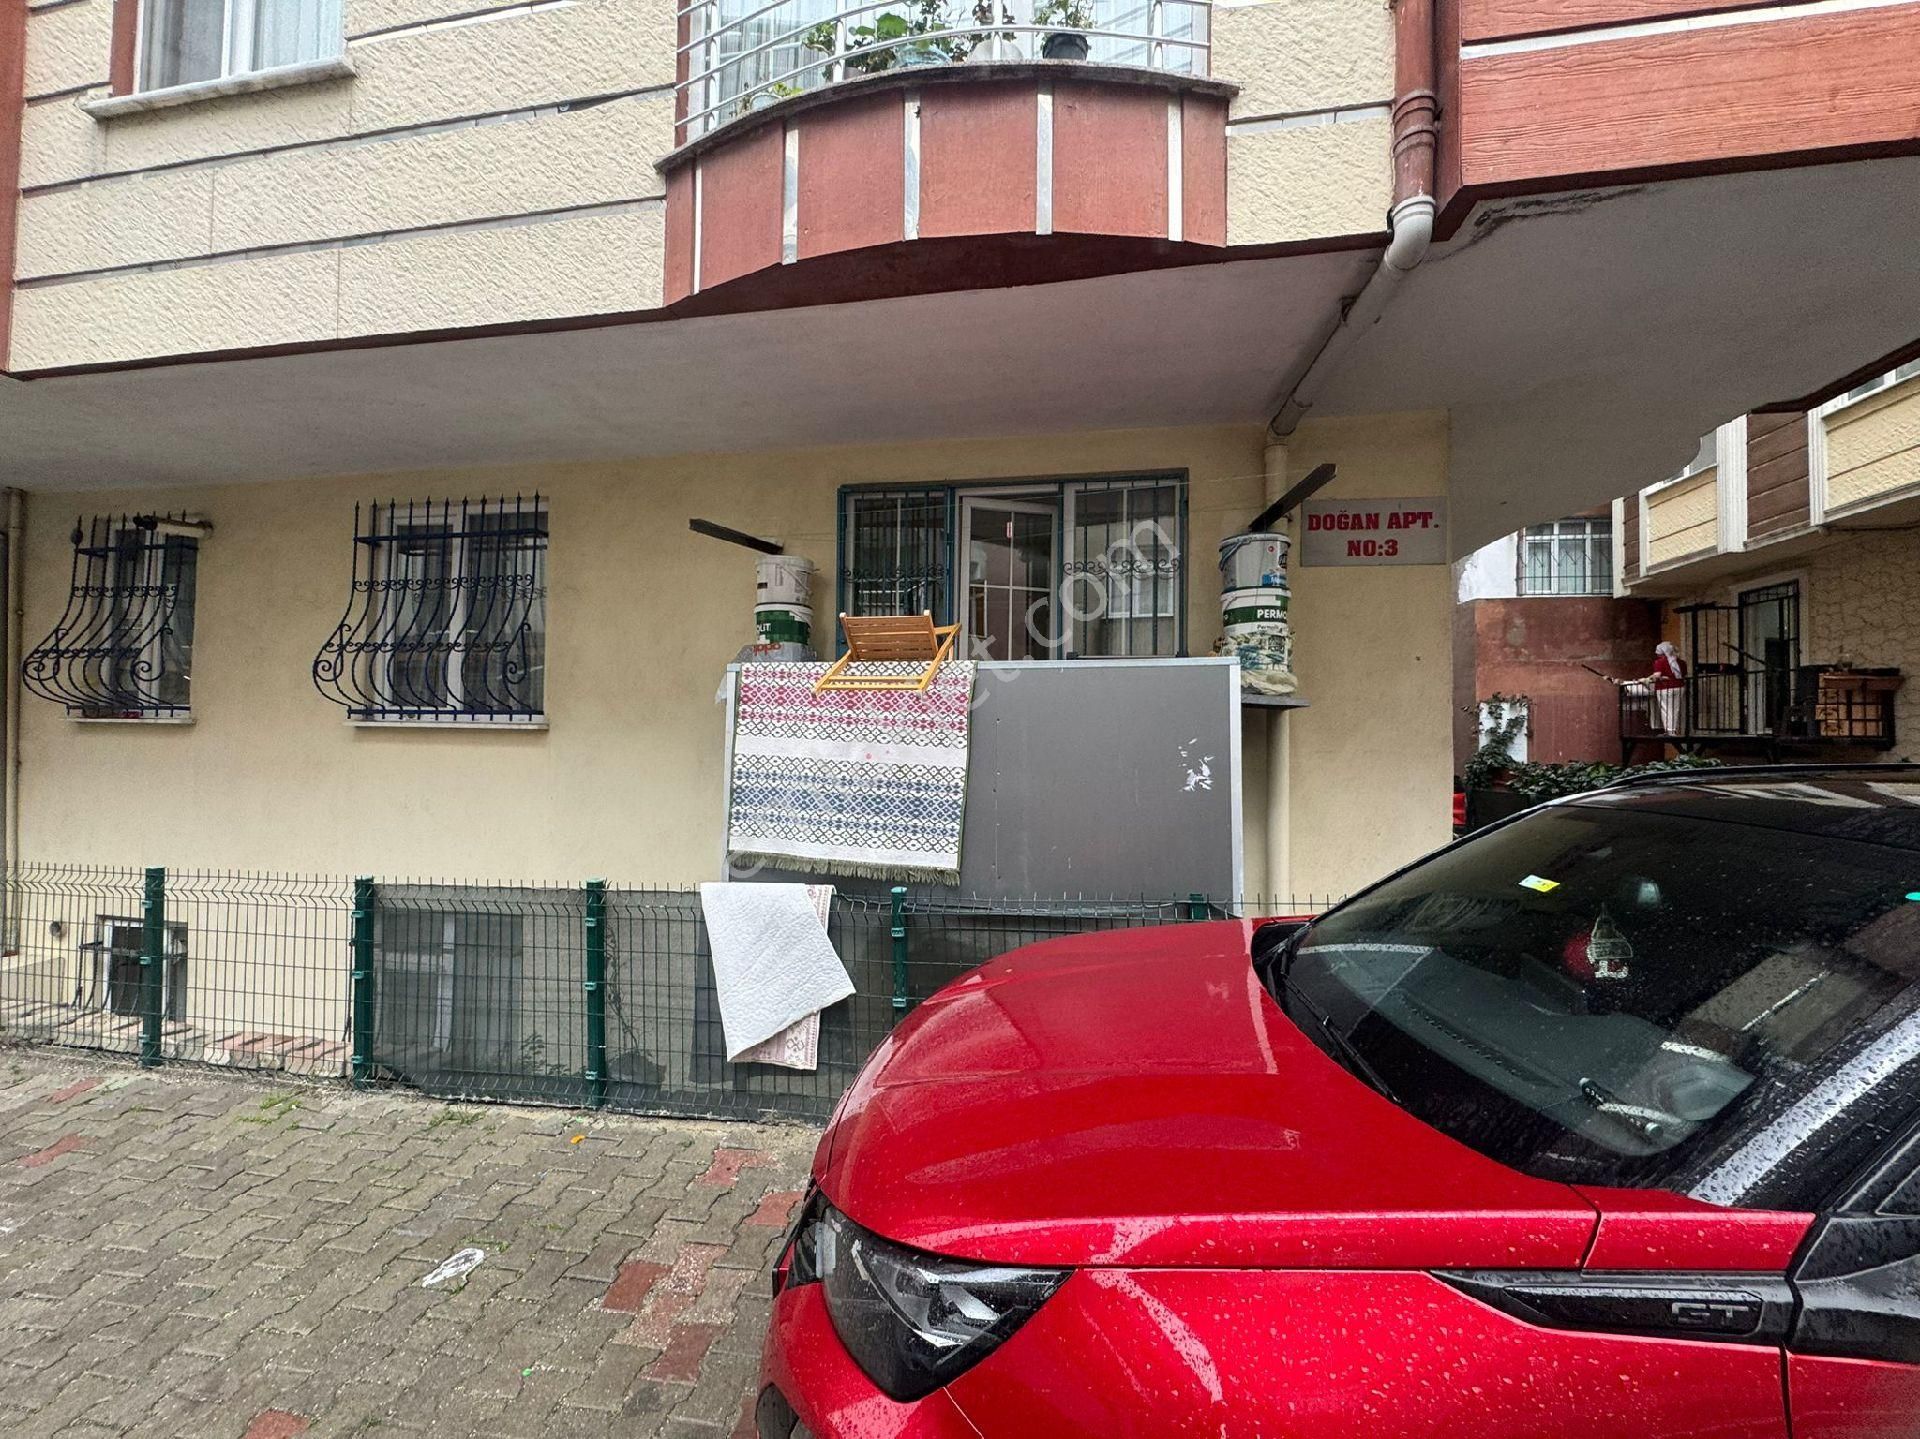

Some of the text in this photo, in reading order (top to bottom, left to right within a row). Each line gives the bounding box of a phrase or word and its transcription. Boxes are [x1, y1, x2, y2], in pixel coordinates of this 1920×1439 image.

[1307, 510, 1440, 531] DOĞAN APT.
[1347, 539, 1399, 557] NO:3
[1671, 1302, 1749, 1325] GT
